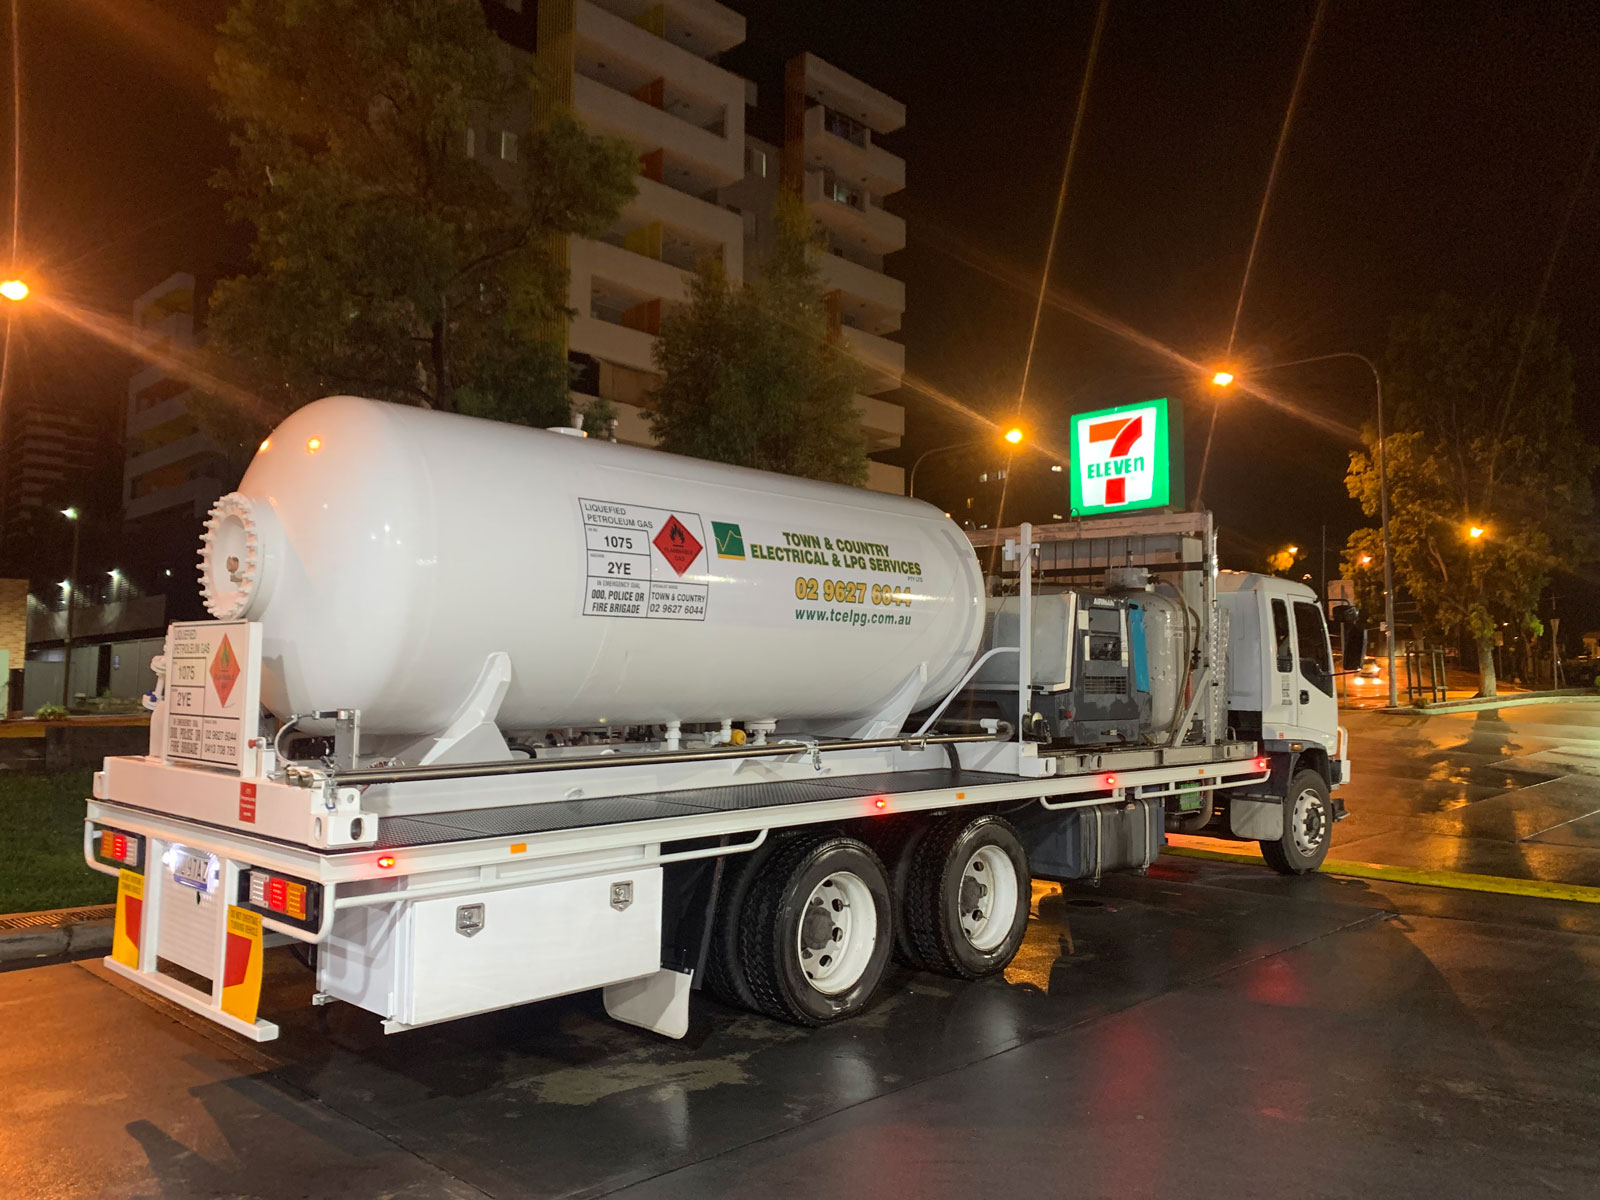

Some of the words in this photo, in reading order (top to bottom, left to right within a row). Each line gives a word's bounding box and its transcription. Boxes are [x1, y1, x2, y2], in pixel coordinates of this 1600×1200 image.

[1089, 416, 1142, 505] 7
[584, 503, 626, 515] LIQUEFIED
[587, 513, 635, 526] PETROLEUM
[637, 519, 653, 528] GAS
[604, 535, 633, 549] 1075
[782, 532, 822, 549] TOWN
[824, 537, 834, 551] &
[835, 538, 889, 557] COUNTRY
[750, 543, 829, 567] ELECTRICAL
[832, 553, 842, 567] &
[844, 554, 867, 570] LPG
[869, 558, 922, 575] SERVICES
[607, 561, 631, 575] 2YE
[608, 589, 633, 602] POLICE
[634, 591, 645, 602] OR
[651, 591, 670, 601] TOWN
[671, 592, 675, 601] &
[677, 593, 705, 602] COUNTRY
[795, 576, 819, 601] 02
[823, 579, 867, 603] 9627
[871, 584, 912, 607] 6044
[592, 602, 608, 612] FIRE
[609, 602, 640, 614] BRIGADE
[650, 603, 660, 613] 02
[662, 604, 682, 614] 9627
[684, 605, 704, 614] 6044
[795, 608, 912, 627] www.tcelpg.com.au
[178, 665, 195, 680] 1075
[177, 691, 191, 707] 2YE
